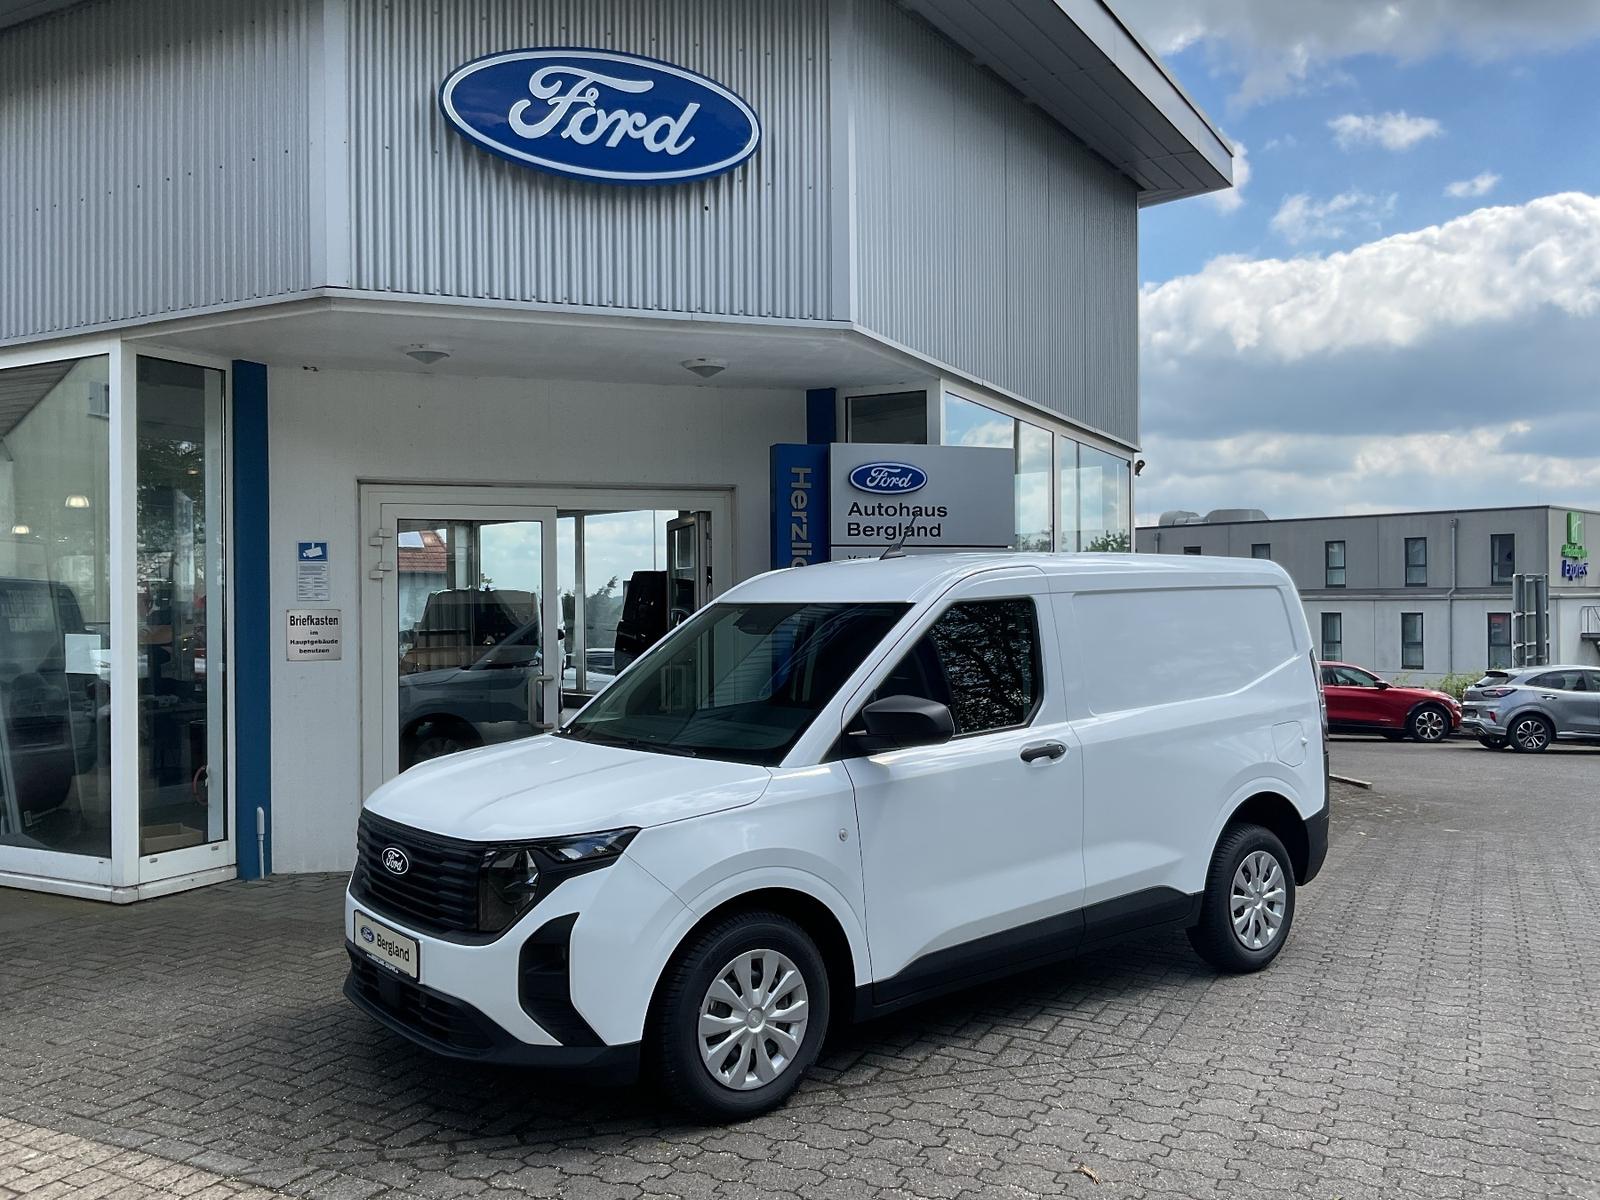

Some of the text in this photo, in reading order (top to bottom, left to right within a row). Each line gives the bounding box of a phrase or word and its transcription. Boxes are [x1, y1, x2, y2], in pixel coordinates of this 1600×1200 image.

[508, 65, 701, 156] Ford
[866, 467, 913, 488] Ford
[847, 501, 948, 518] Autohaus
[847, 522, 942, 541] Bergland
[290, 614, 339, 626] Briefkasten
[385, 850, 404, 871] Ford
[376, 932, 410, 962] Bergland
